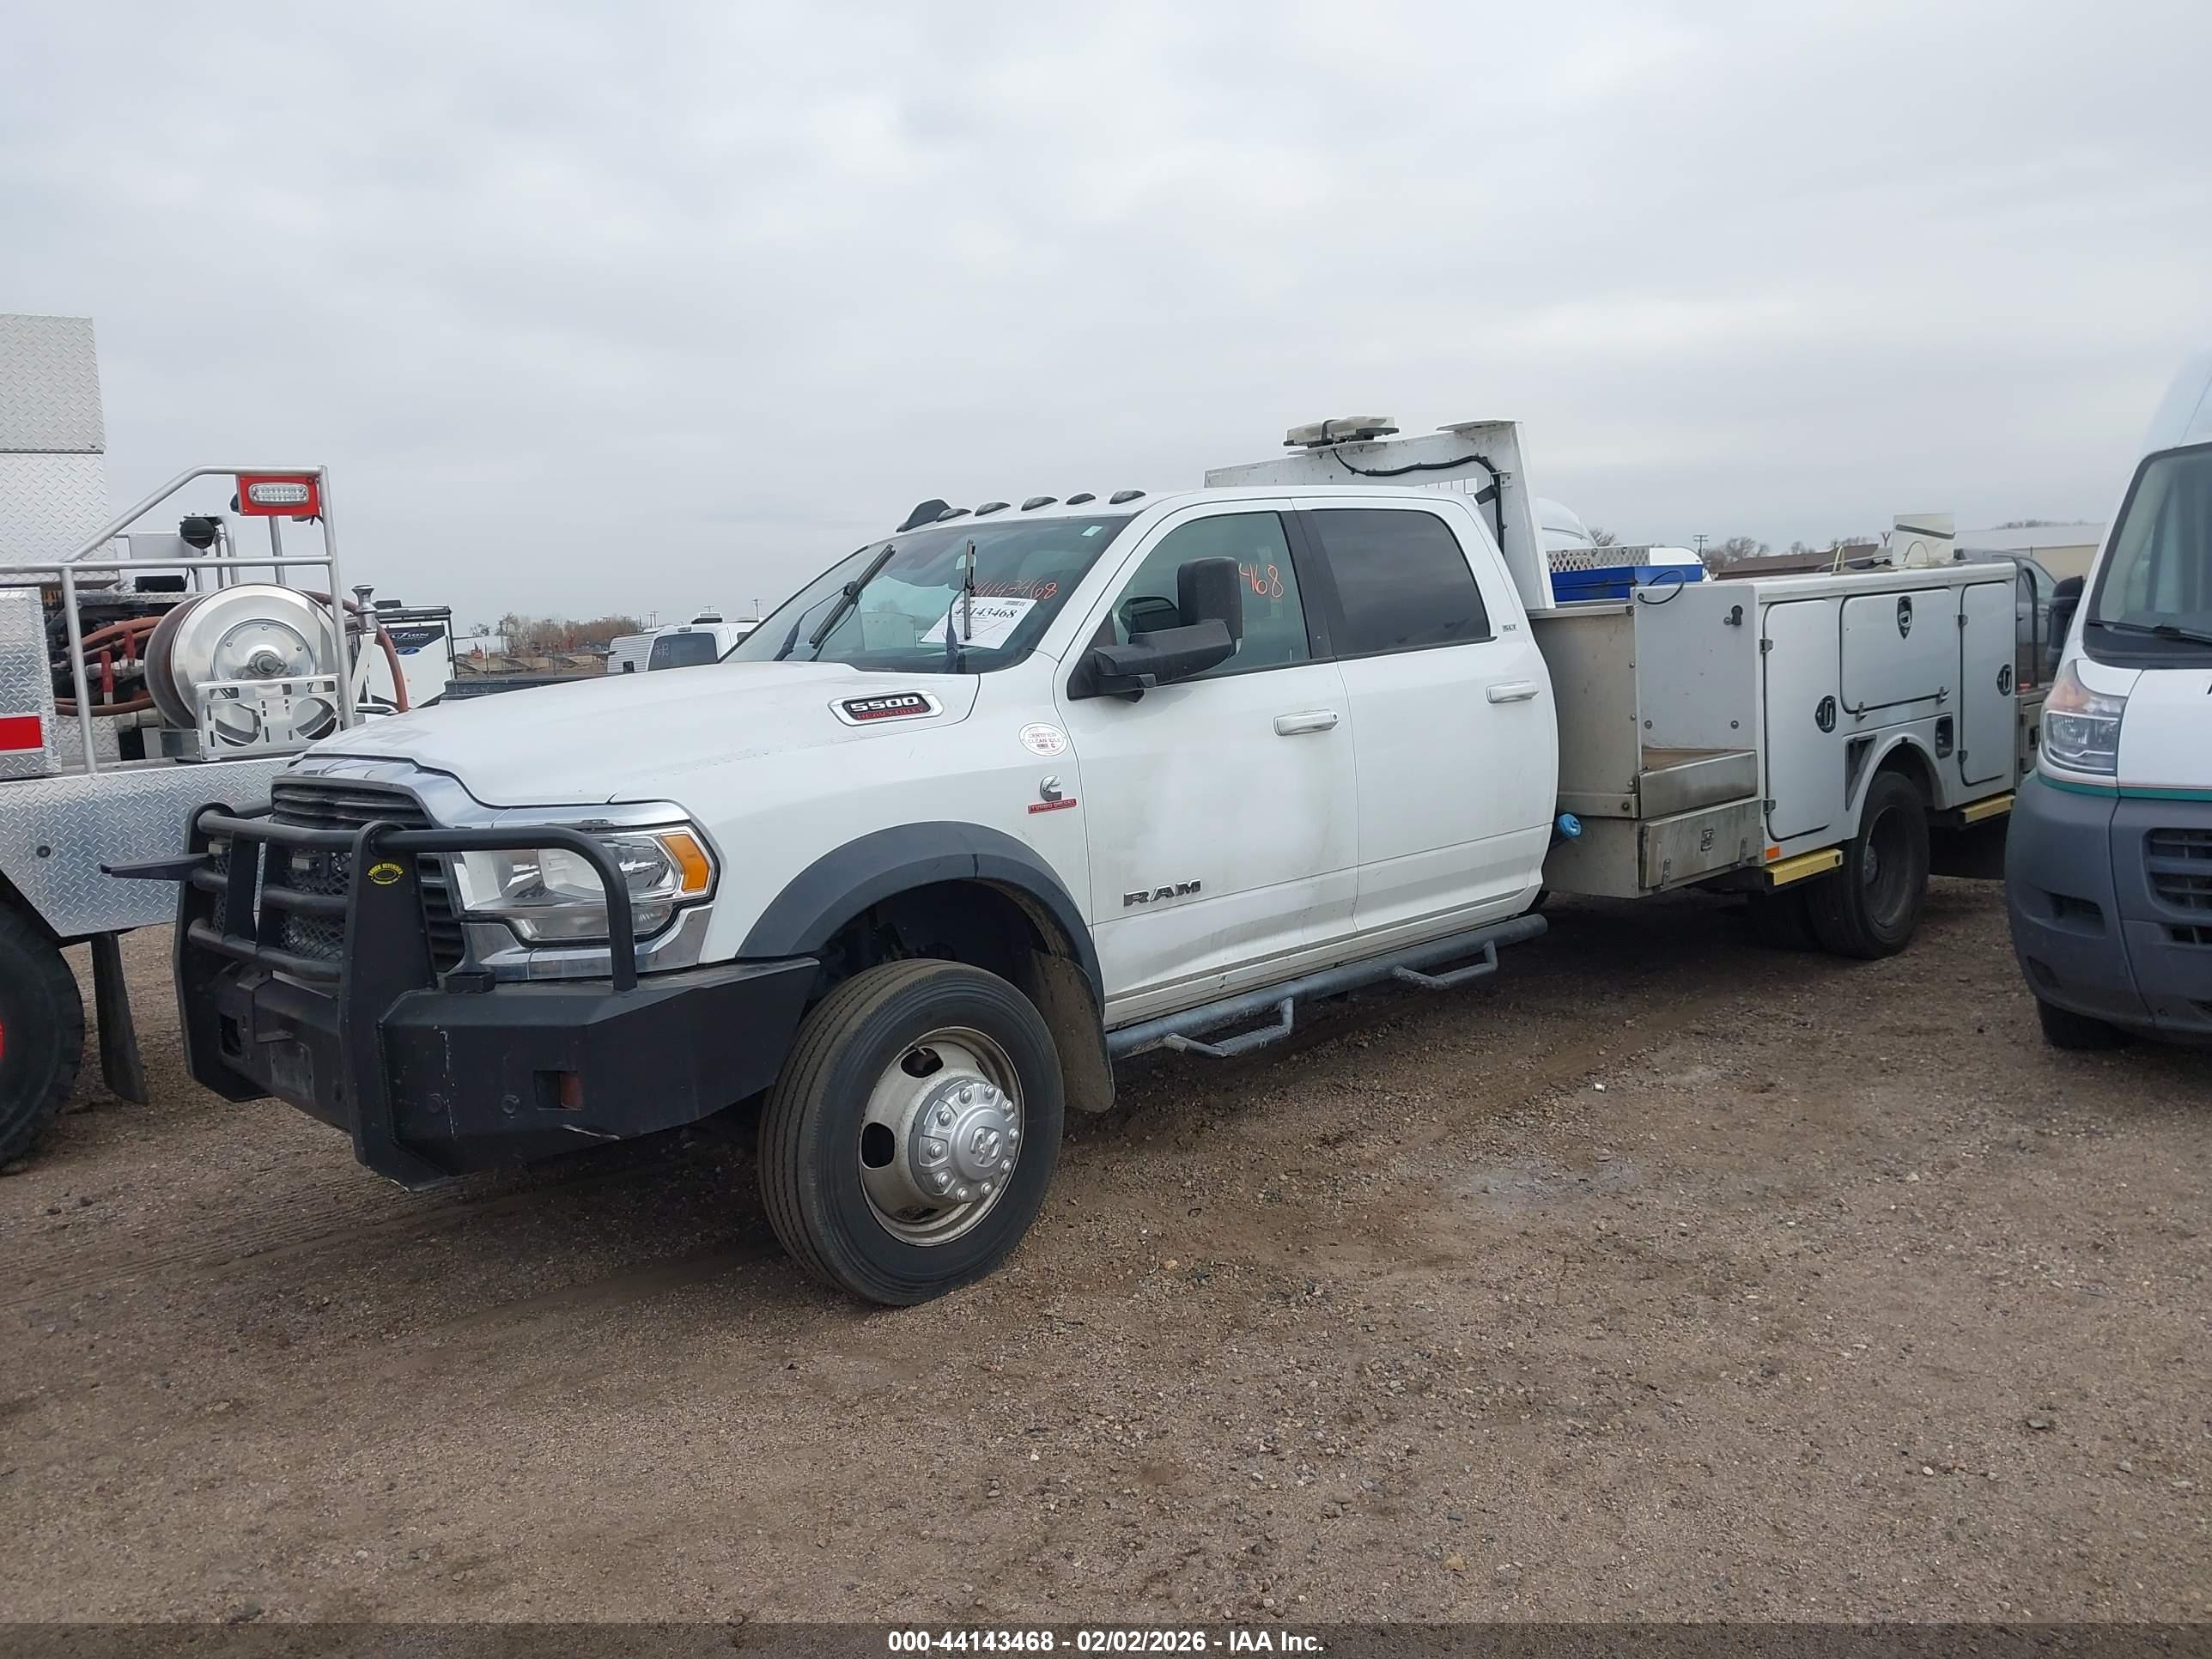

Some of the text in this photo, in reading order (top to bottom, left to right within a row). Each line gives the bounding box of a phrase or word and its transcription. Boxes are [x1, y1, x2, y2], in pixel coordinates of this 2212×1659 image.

[955, 606, 1018, 618] 4143468
[850, 696, 920, 712] 5500
[1123, 878, 1201, 907] RAM
